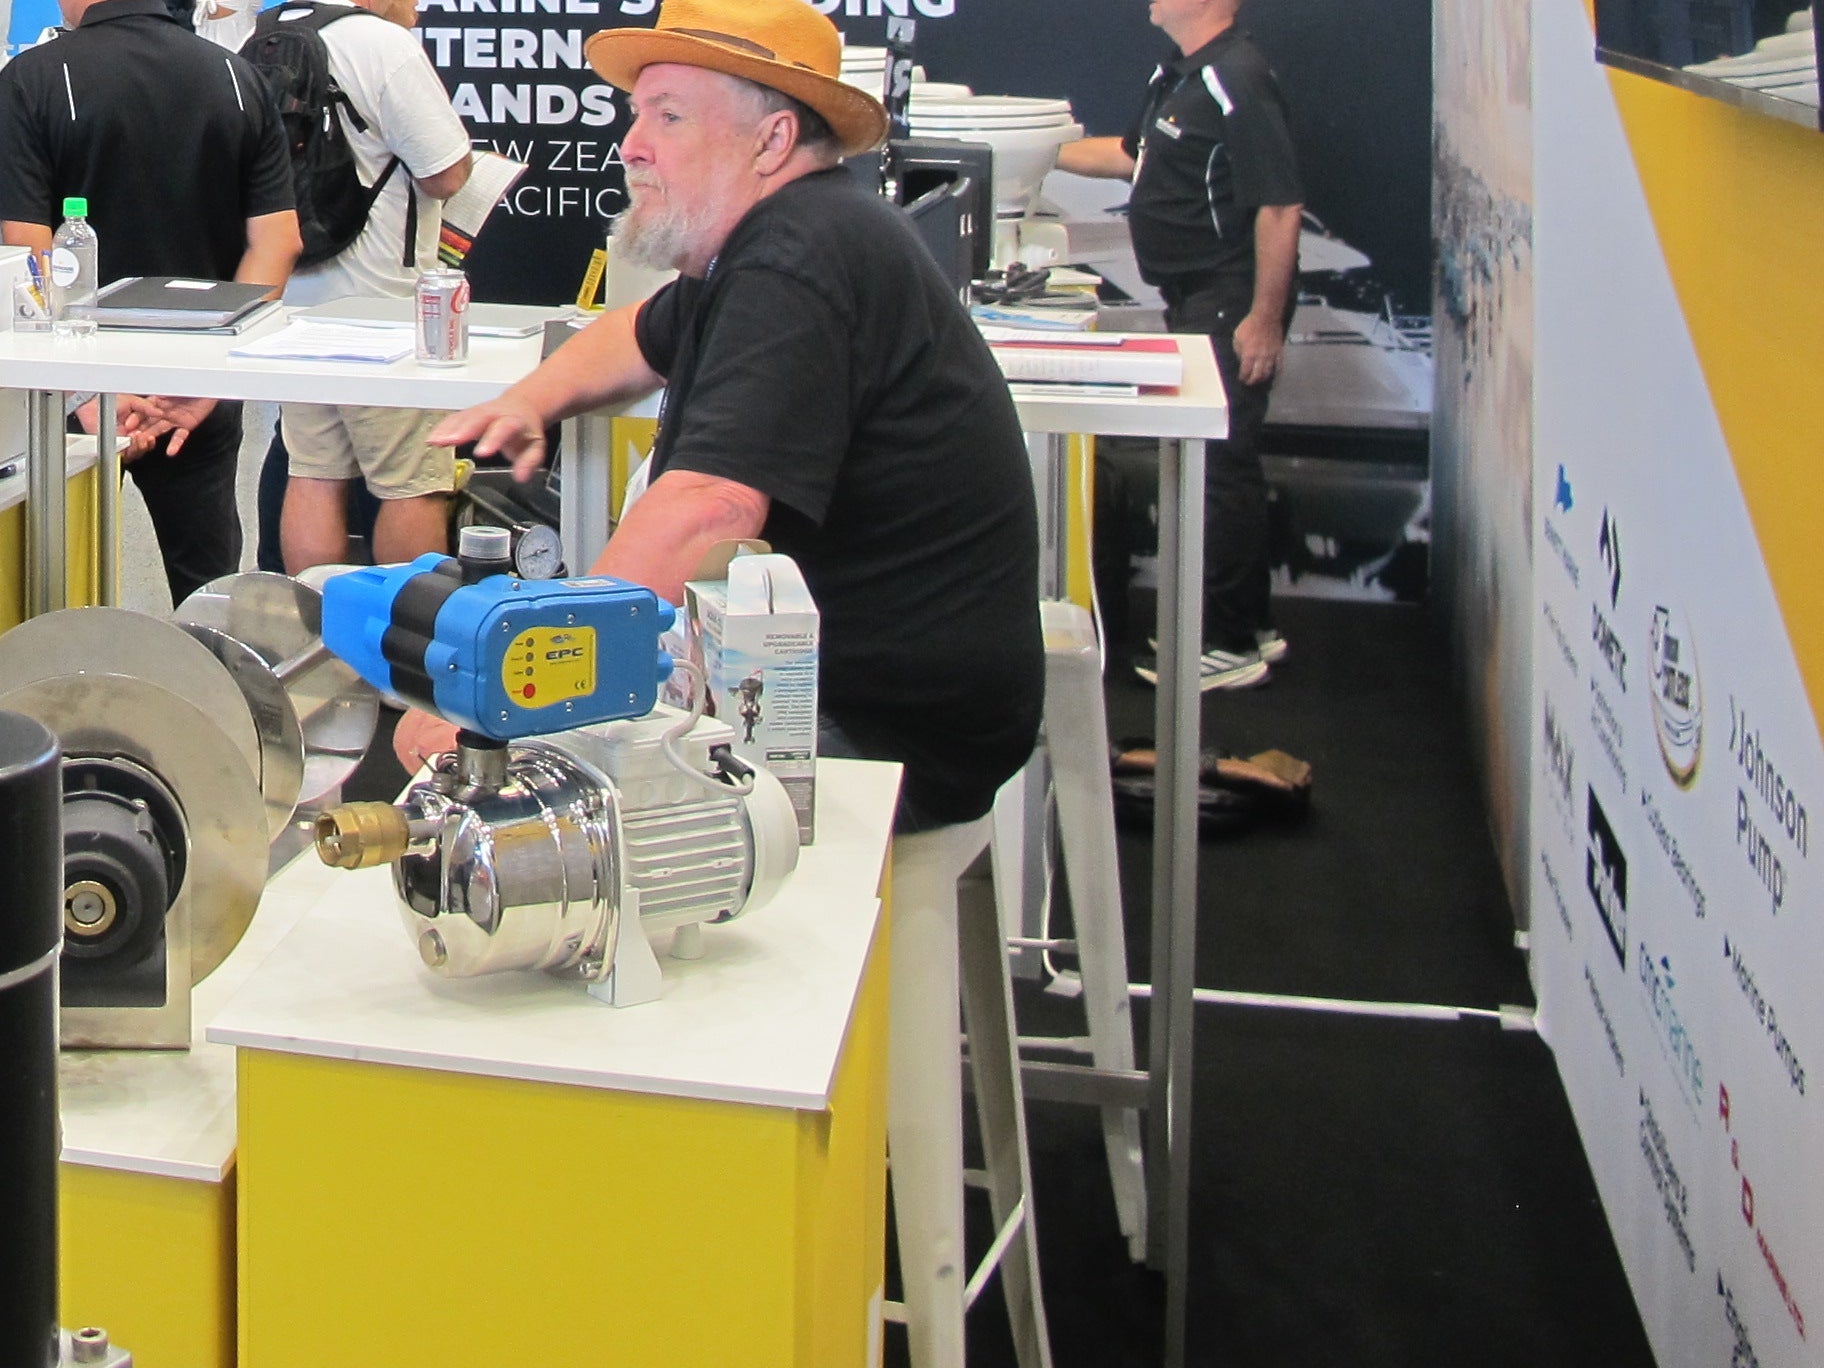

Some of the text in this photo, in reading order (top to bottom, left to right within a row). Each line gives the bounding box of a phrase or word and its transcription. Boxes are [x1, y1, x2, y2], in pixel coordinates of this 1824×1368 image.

[451, 82, 617, 127] ANDS
[545, 647, 584, 660] EPC
[1738, 710, 1807, 859] Johnson
[1737, 786, 1784, 917] Pump
[1732, 944, 1805, 1097] Marine Pumps
[1742, 1174, 1754, 1228] D
